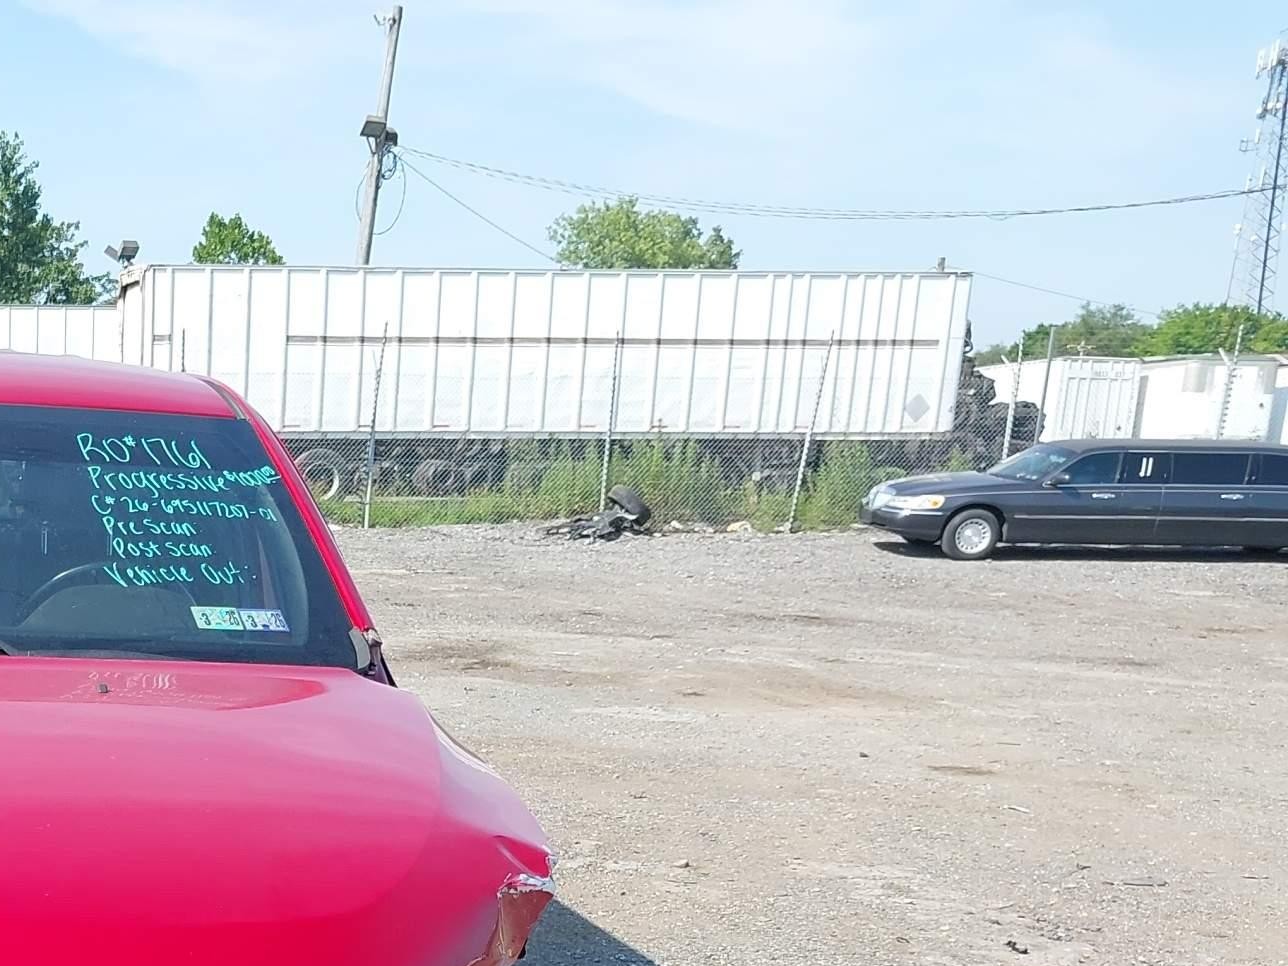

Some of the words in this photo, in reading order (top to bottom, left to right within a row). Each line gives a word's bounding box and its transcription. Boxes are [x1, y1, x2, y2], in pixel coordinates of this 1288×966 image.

[88, 466, 230, 498] Progressive
[112, 537, 161, 558] Post
[103, 561, 193, 587] Vehicle
